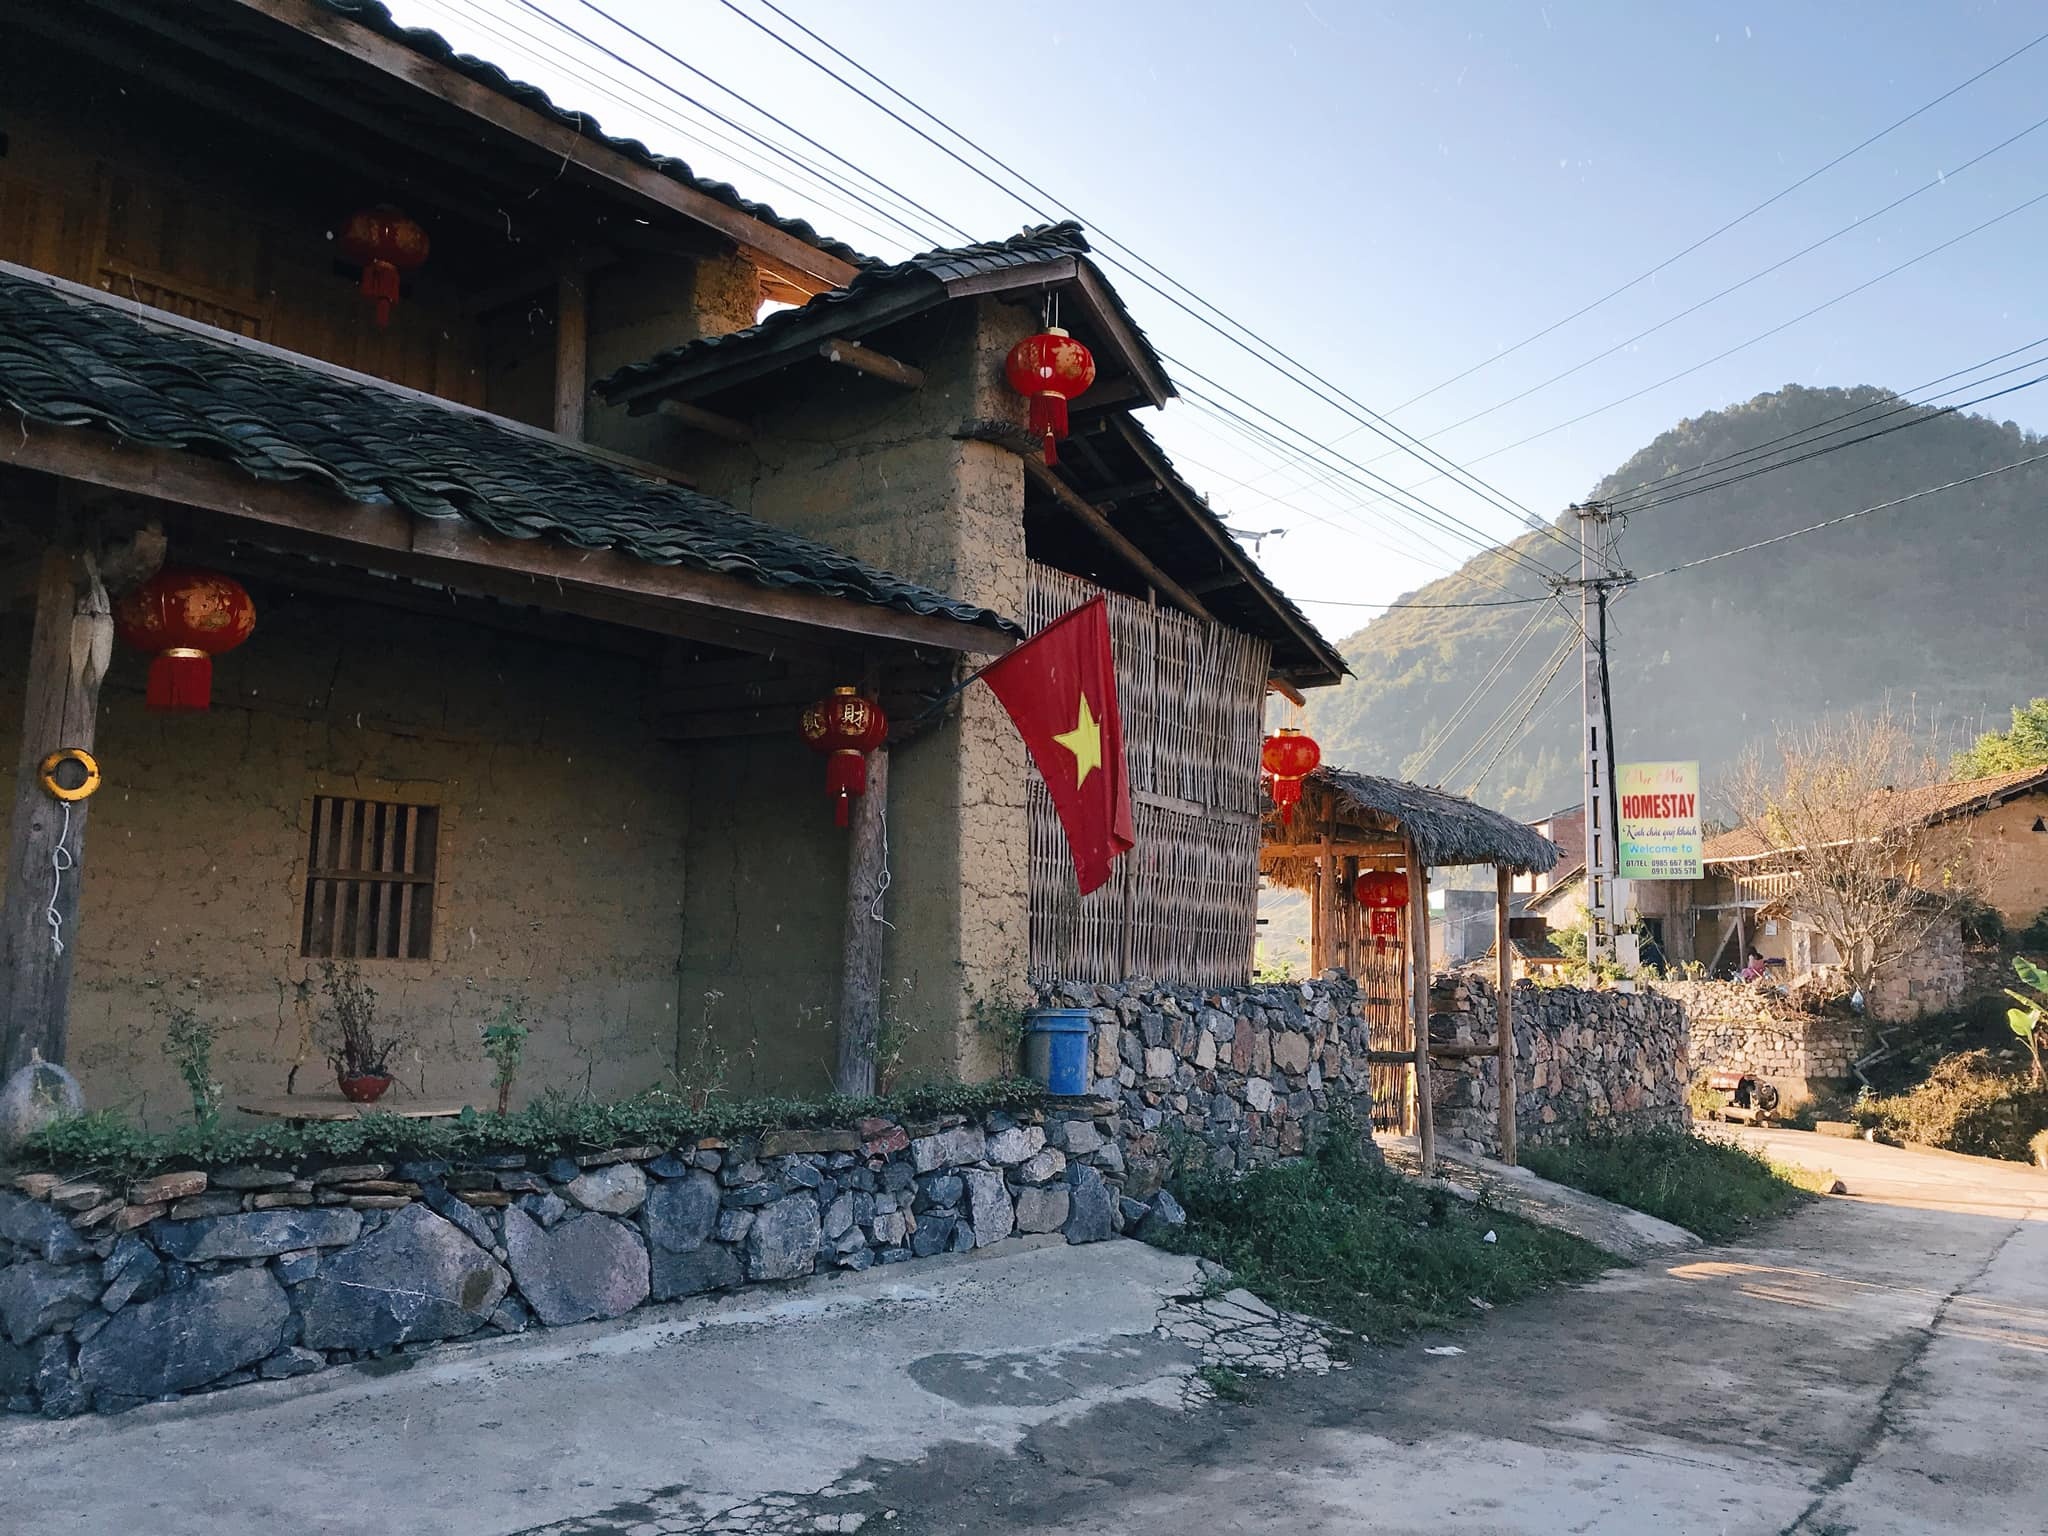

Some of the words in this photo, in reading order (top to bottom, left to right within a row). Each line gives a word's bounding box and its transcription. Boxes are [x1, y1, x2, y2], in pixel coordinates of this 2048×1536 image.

[841, 703, 865, 727] 財
[1622, 793, 1696, 820] HOMESTAY
[1629, 843, 1678, 854] Welcome
[1682, 843, 1693, 854] to
